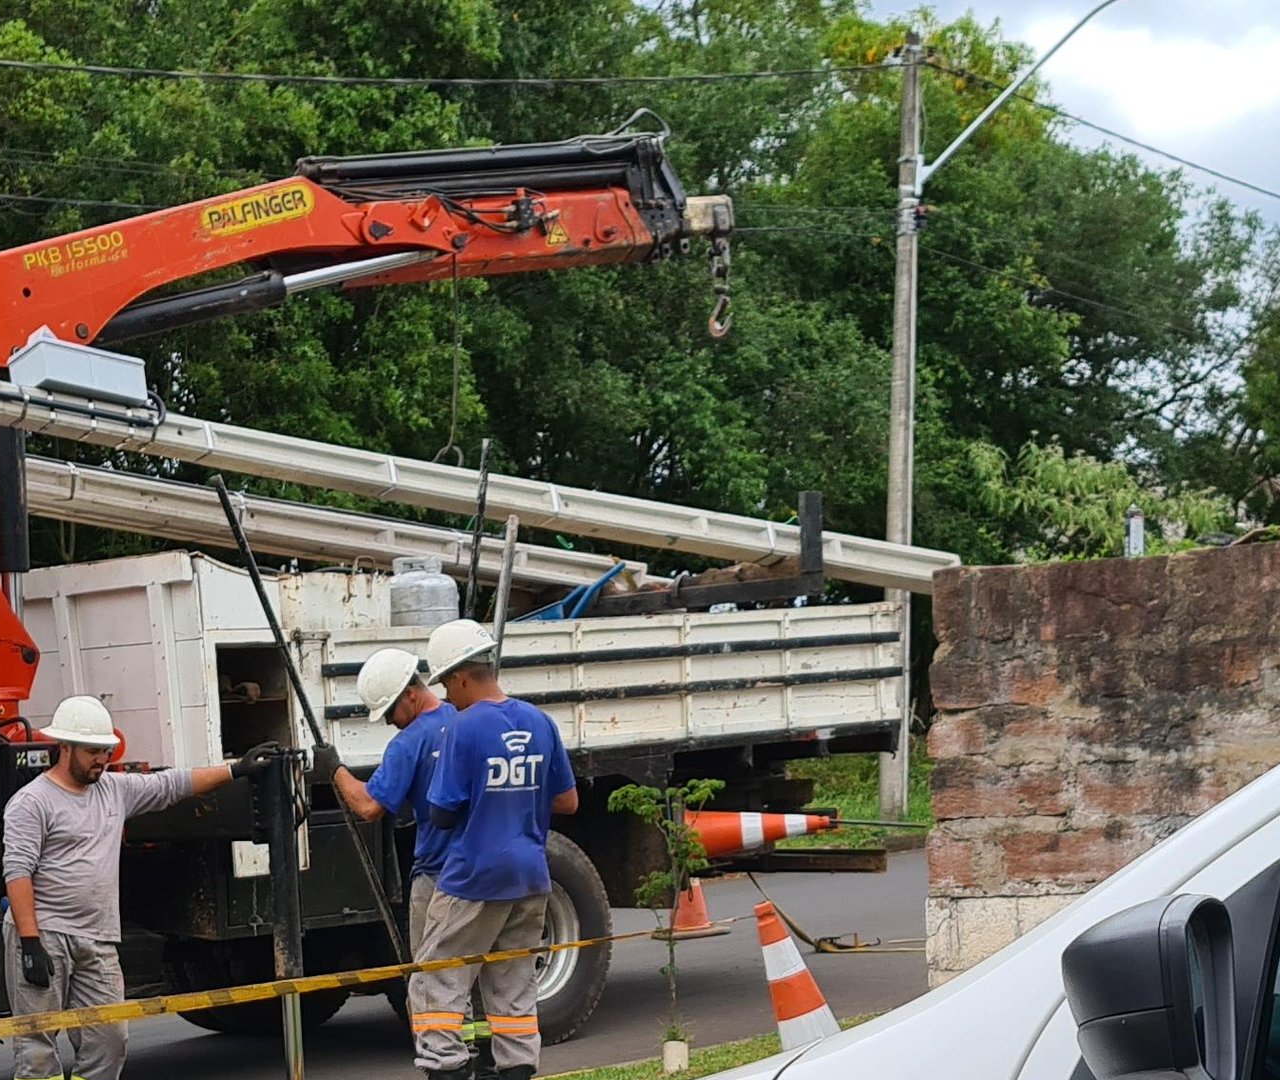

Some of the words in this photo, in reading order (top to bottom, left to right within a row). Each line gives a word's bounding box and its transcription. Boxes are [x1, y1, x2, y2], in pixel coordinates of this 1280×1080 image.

[208, 190, 307, 230] PALFINGER
[23, 246, 62, 270] PKB
[66, 231, 124, 258] 15500
[486, 754, 544, 787] DGT
